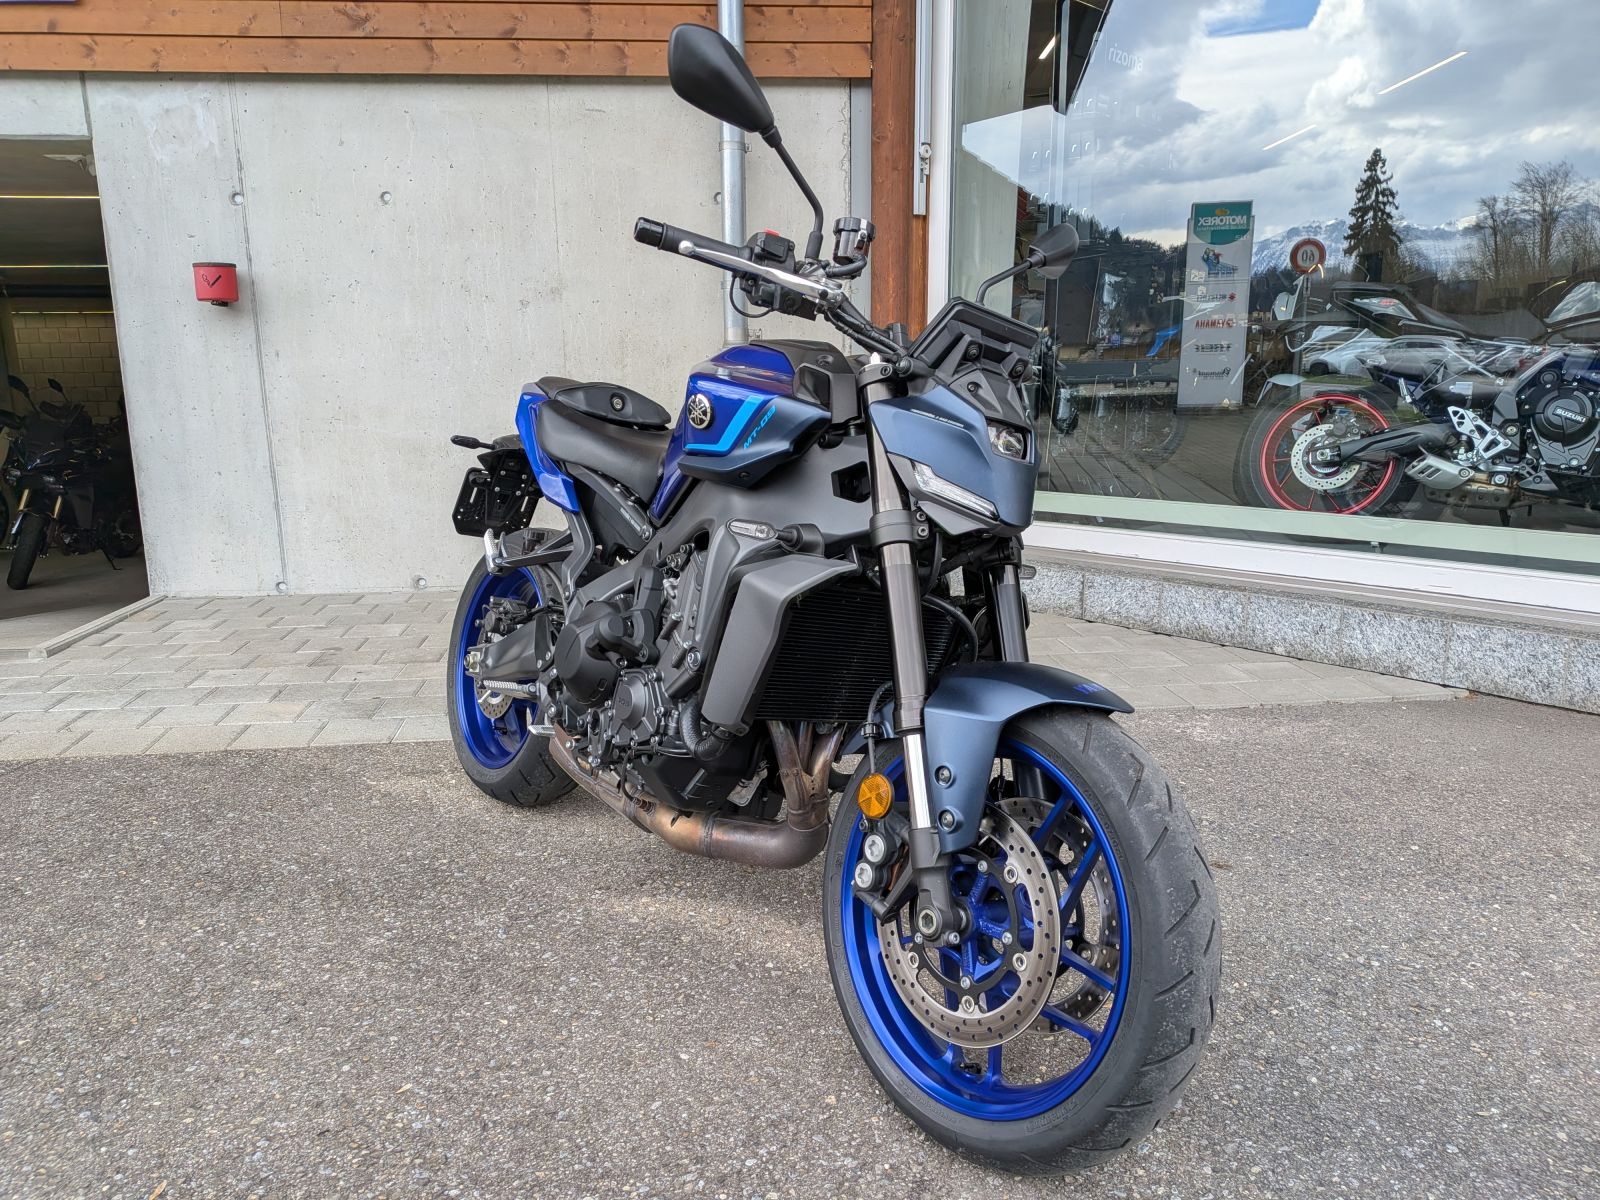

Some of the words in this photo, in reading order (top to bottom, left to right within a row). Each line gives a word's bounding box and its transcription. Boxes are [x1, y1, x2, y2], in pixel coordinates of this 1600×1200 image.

[1108, 44, 1144, 72] rizoma
[743, 405, 777, 450] MT-09
[1556, 408, 1587, 423] SUZUKI
